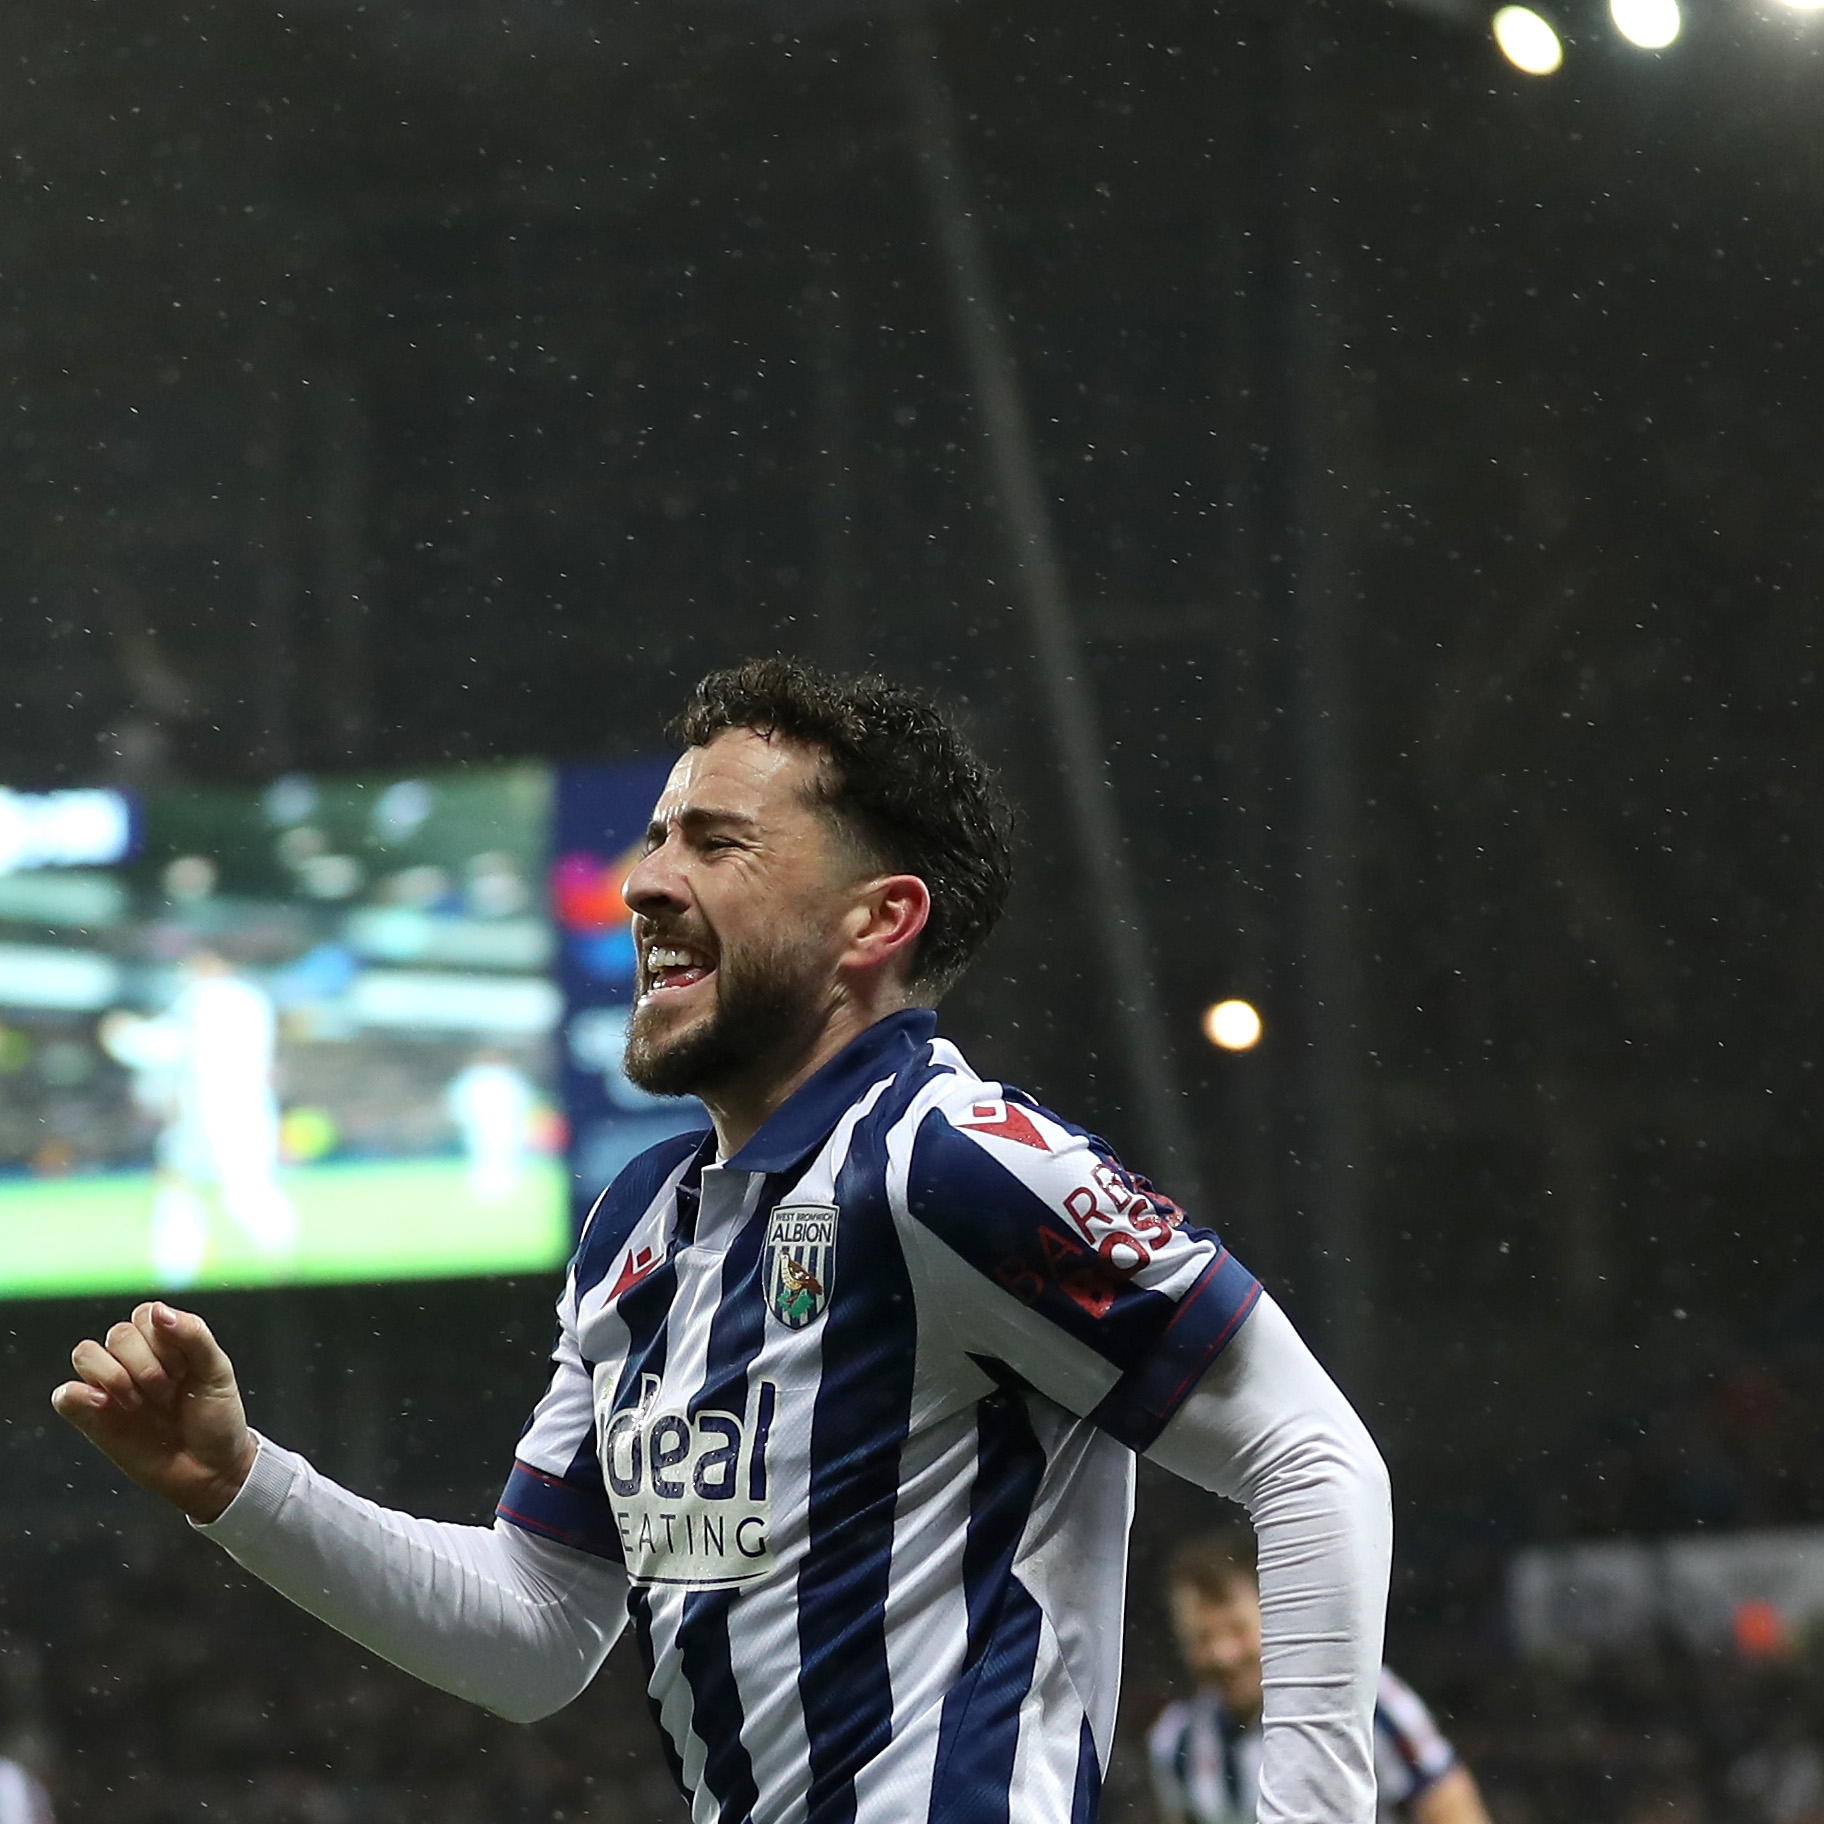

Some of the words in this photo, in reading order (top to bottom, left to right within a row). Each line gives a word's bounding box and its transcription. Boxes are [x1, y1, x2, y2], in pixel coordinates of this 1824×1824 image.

[776, 1213, 795, 1221] WEST
[771, 1223, 833, 1243] ALBION
[617, 1512, 767, 1558] EATING
